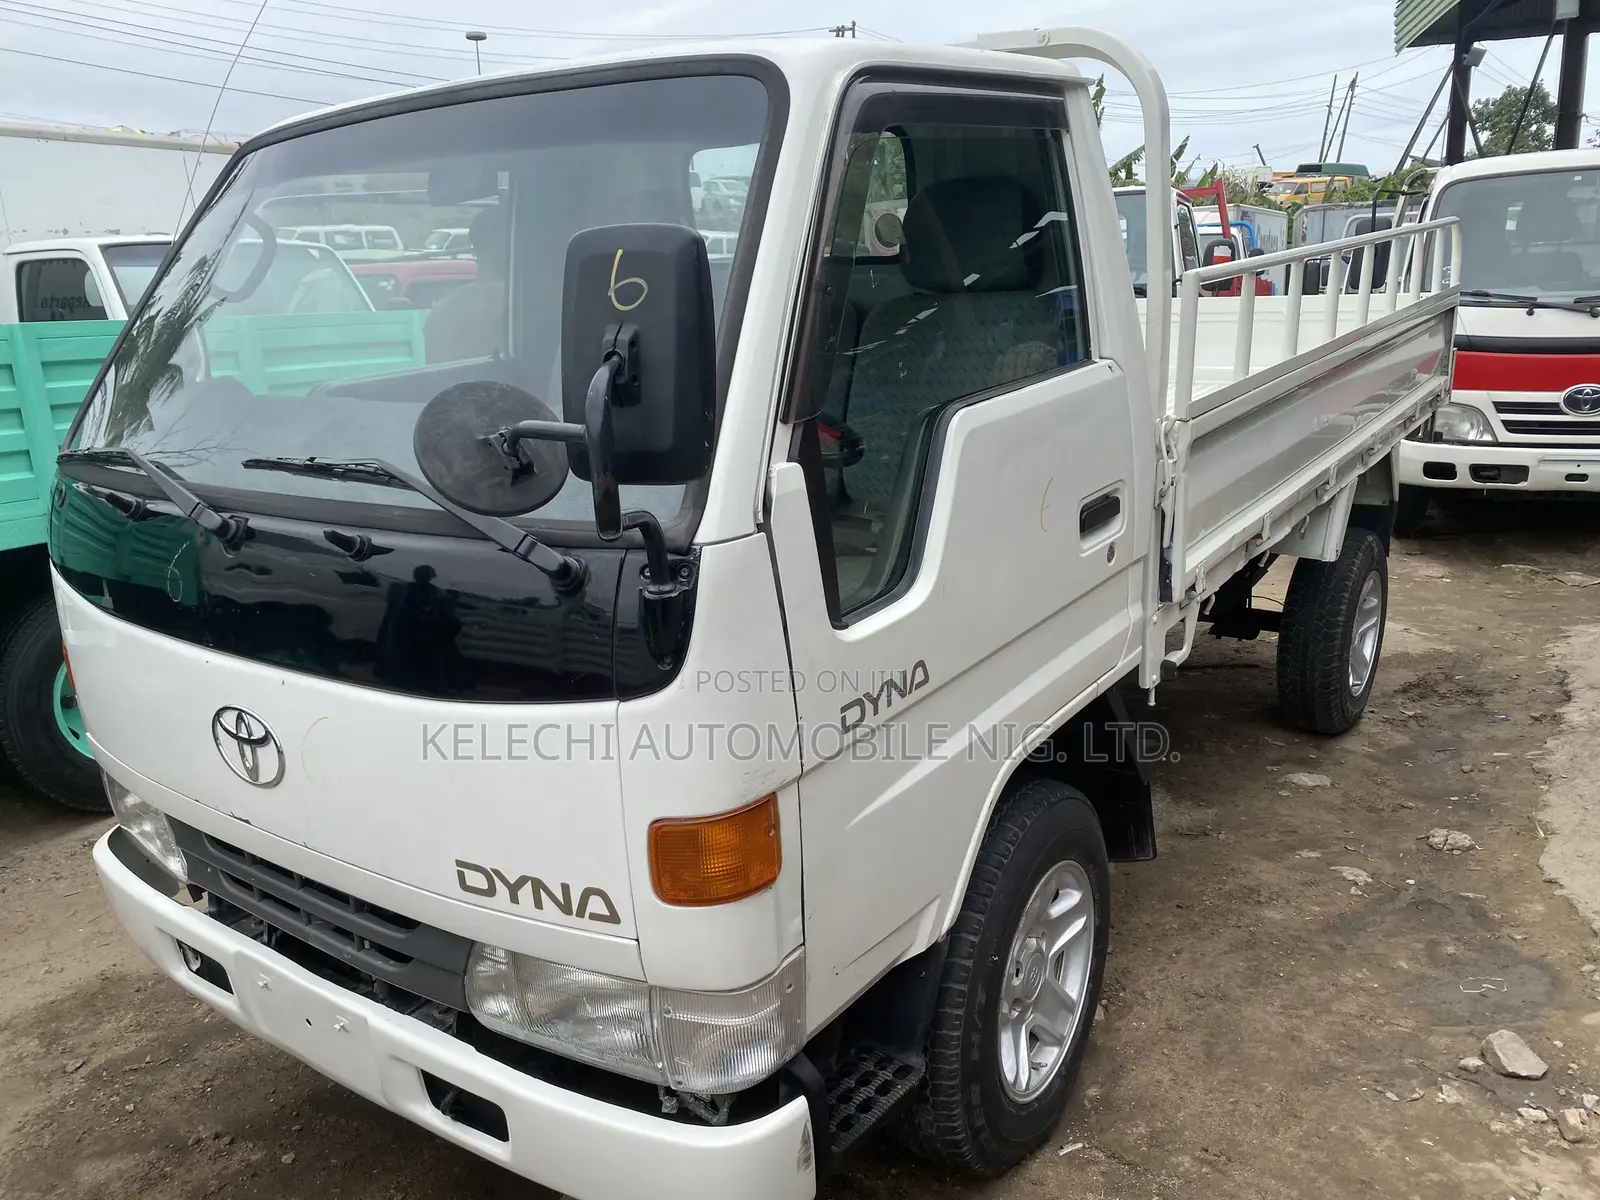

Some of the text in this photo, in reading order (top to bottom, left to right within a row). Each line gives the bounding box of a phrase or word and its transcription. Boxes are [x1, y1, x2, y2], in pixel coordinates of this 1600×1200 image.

[608, 249, 648, 311] 6
[840, 660, 930, 735] DYNA
[455, 859, 621, 925] DYNA
